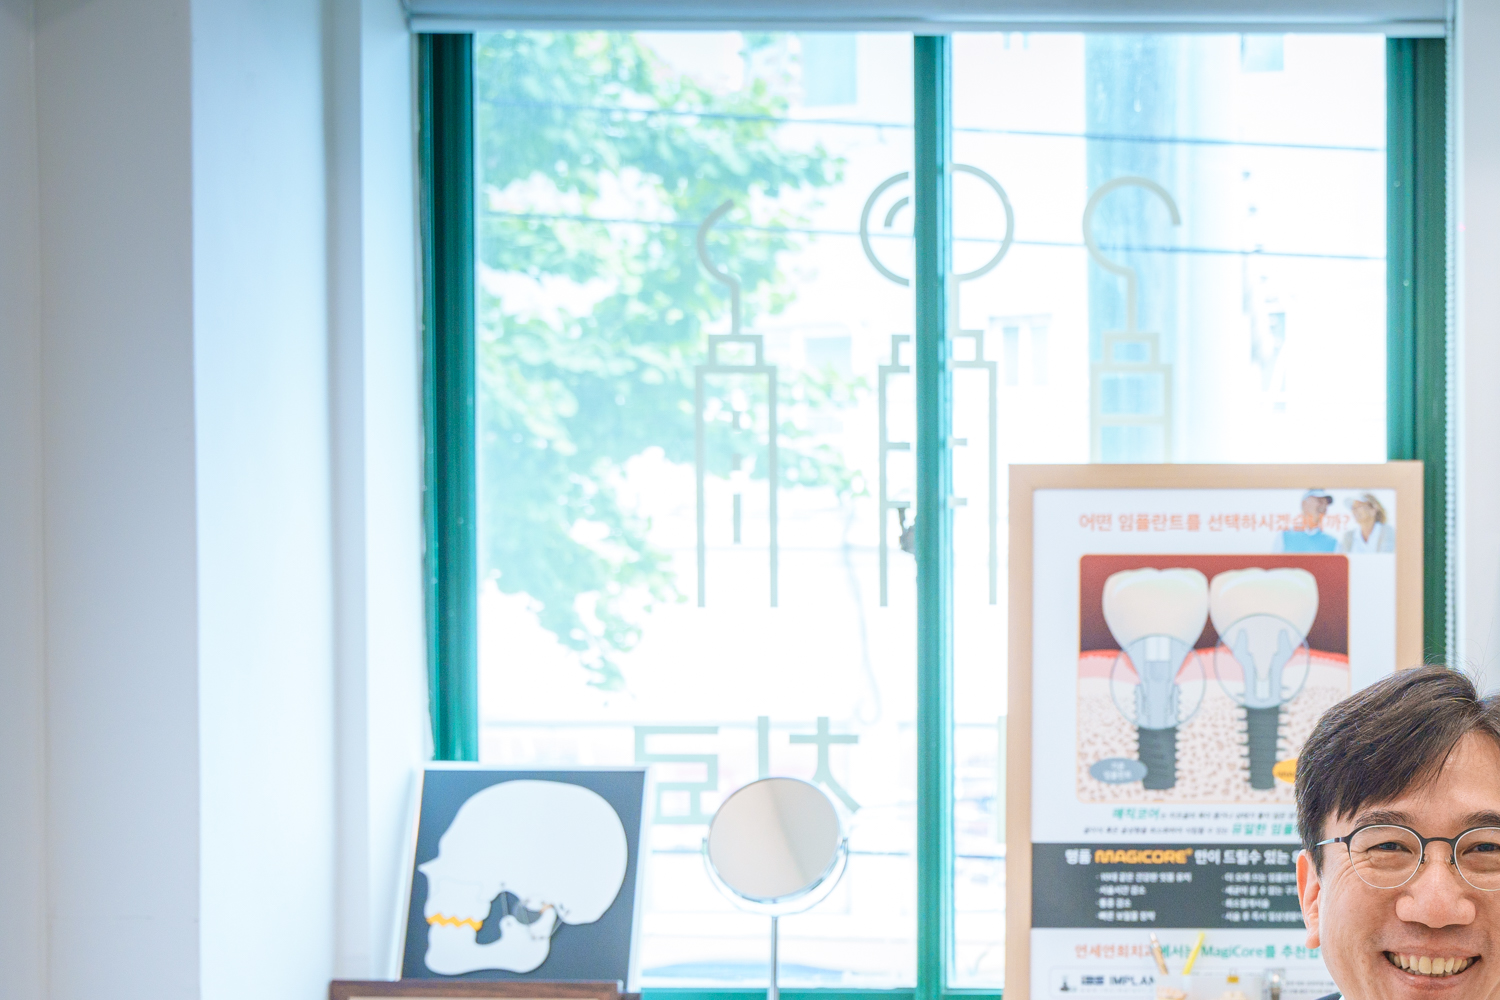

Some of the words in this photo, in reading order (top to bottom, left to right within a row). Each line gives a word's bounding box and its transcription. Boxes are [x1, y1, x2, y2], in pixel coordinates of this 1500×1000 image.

[1079, 513, 1112, 531] 어떤
[1118, 513, 1201, 531] 임플란트를
[1207, 513, 1350, 532] 선택하시겠습니까?
[1201, 944, 1275, 959] MagiCore를
